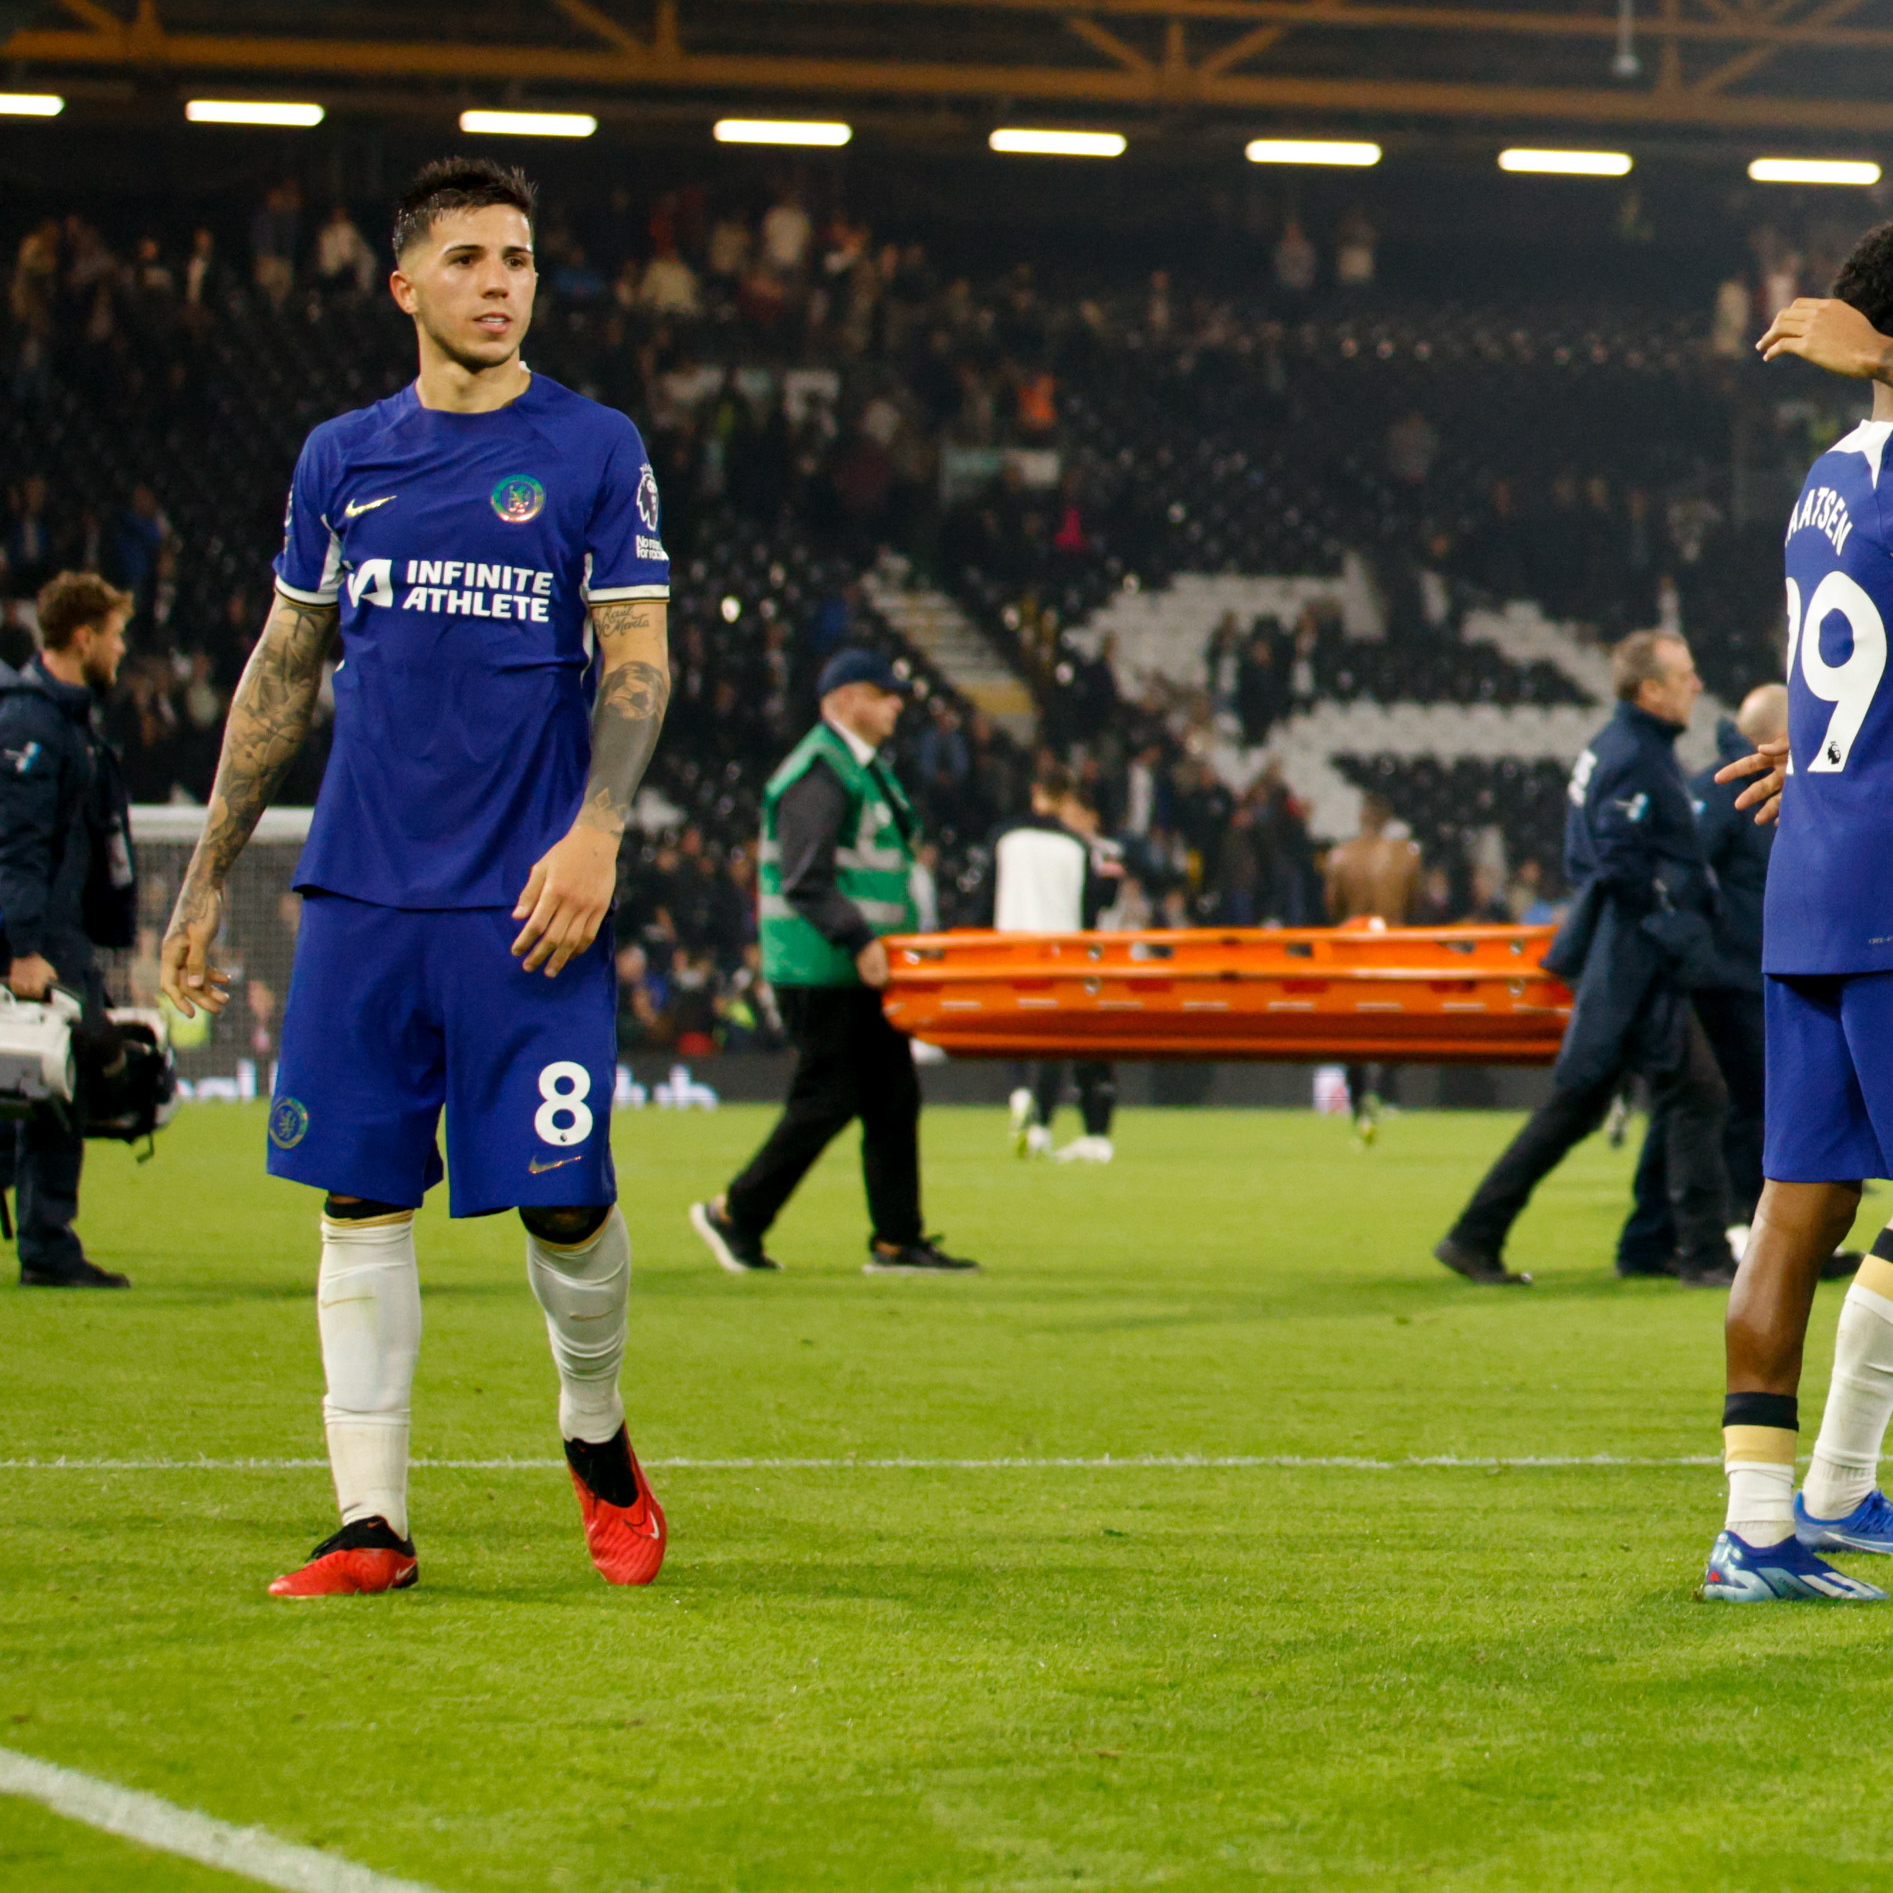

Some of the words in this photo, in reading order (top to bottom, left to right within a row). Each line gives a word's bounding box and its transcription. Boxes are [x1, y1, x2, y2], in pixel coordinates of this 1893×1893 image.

[1785, 486, 1854, 557] AATSEN
[402, 586, 550, 623] ATHLETE
[406, 559, 554, 596] INFINITE
[1785, 570, 1888, 775] 9
[534, 1060, 593, 1147] 8
